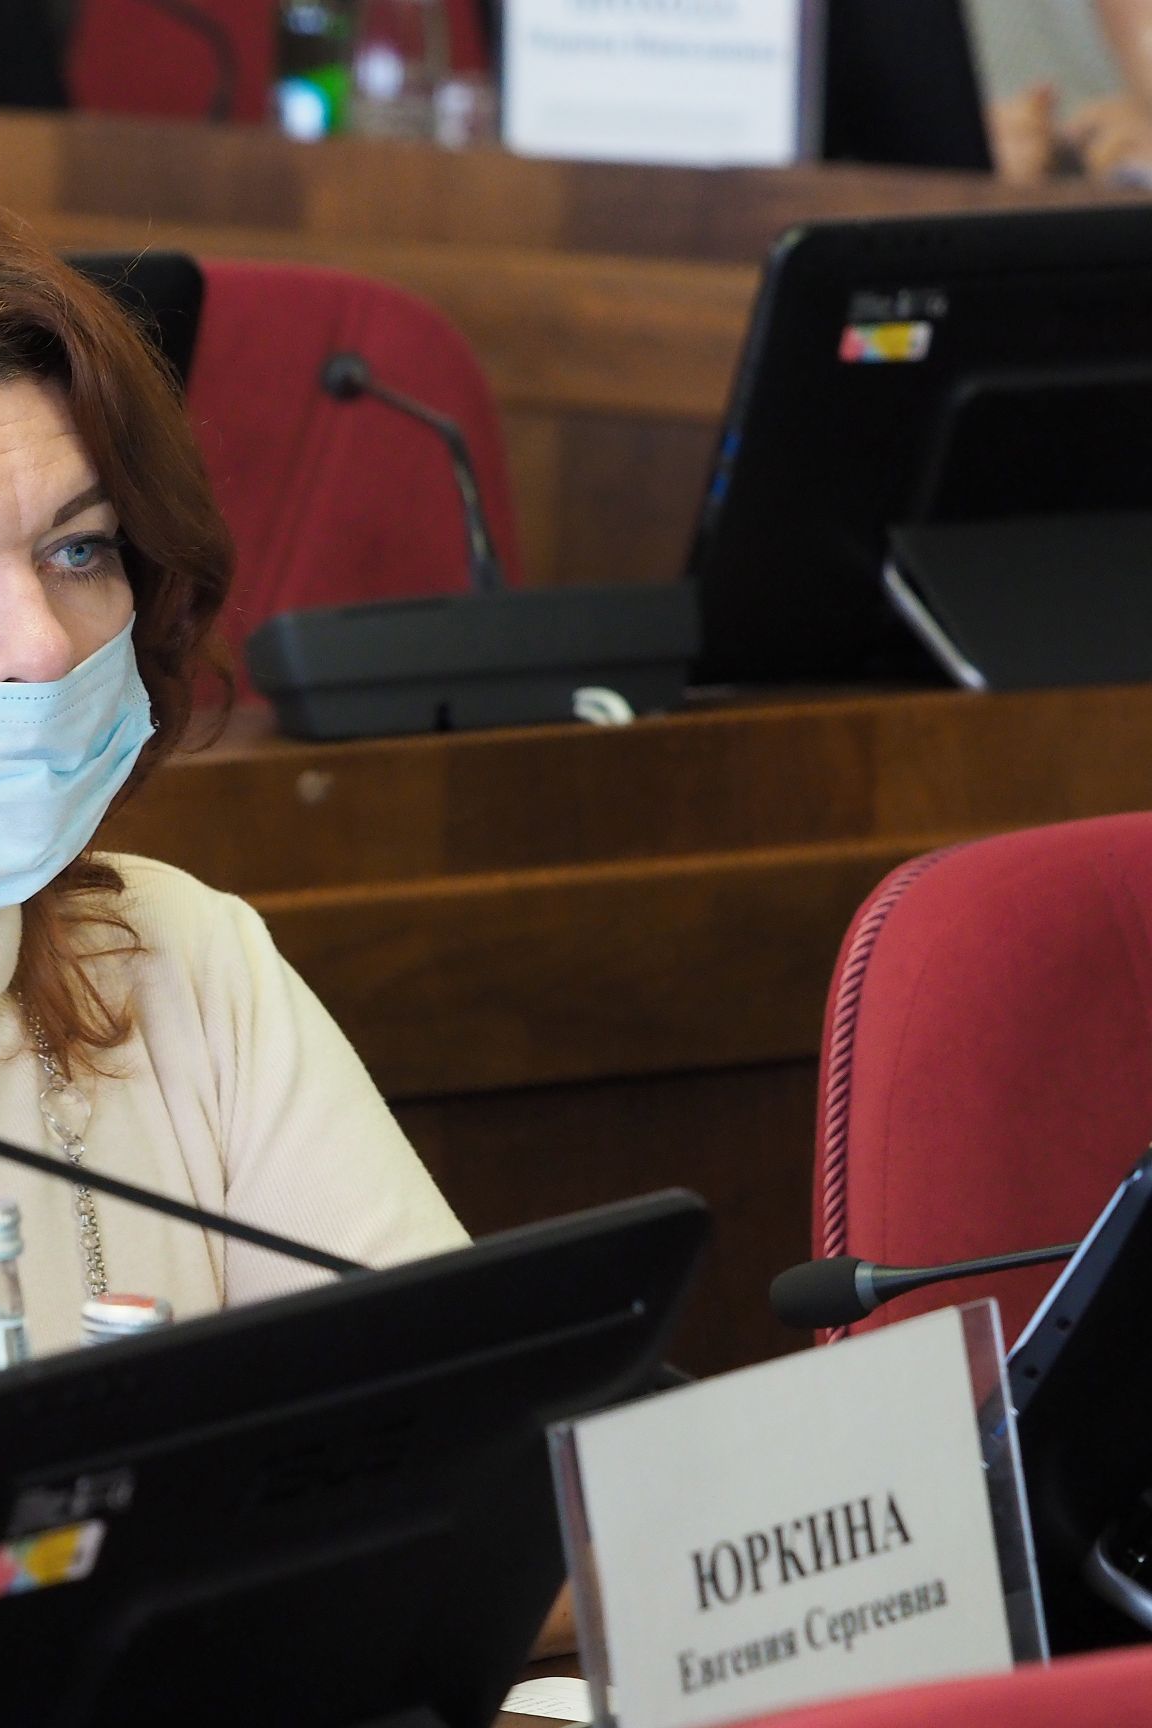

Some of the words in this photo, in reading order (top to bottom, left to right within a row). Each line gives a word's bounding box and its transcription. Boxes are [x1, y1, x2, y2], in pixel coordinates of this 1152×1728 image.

[692, 1491, 911, 1610] ЮРКИНА
[678, 1628, 798, 1694] Евгения
[805, 1580, 949, 1651] Сергеевна
